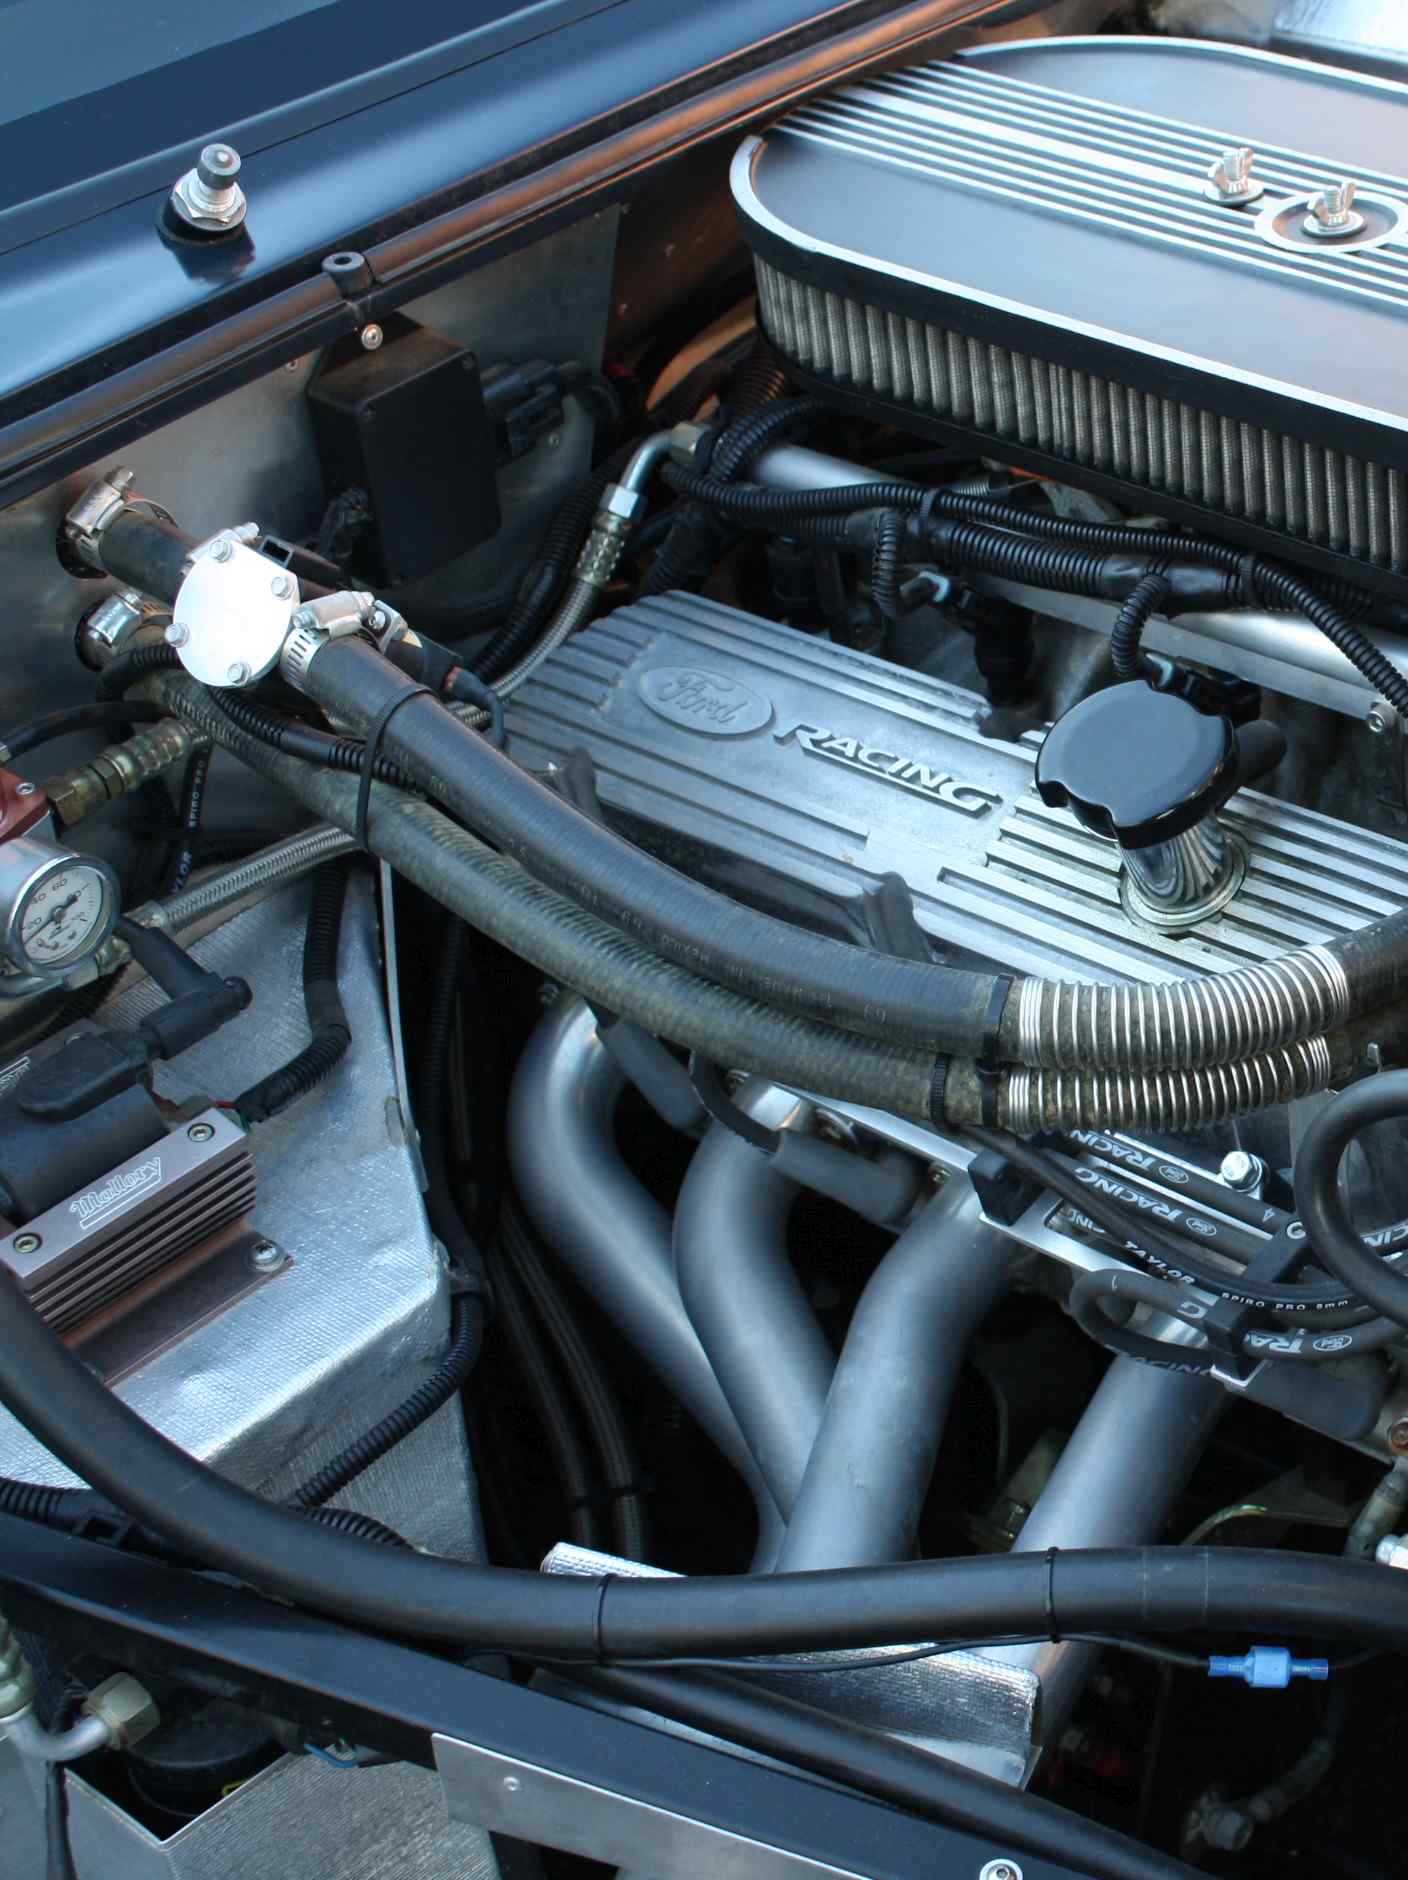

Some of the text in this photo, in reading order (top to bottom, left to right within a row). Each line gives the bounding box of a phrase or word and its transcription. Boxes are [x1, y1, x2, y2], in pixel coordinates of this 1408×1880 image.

[657, 672, 1003, 818] Ford RACING
[1070, 1129, 1158, 1171] RACIN
[69, 1157, 161, 1220] Mallory
[1074, 1167, 1184, 1222] RACING
[1125, 1240, 1195, 1284] TAYLOR
[1222, 1291, 1265, 1308] SPIRO
[1275, 1303, 1306, 1313] PRO
